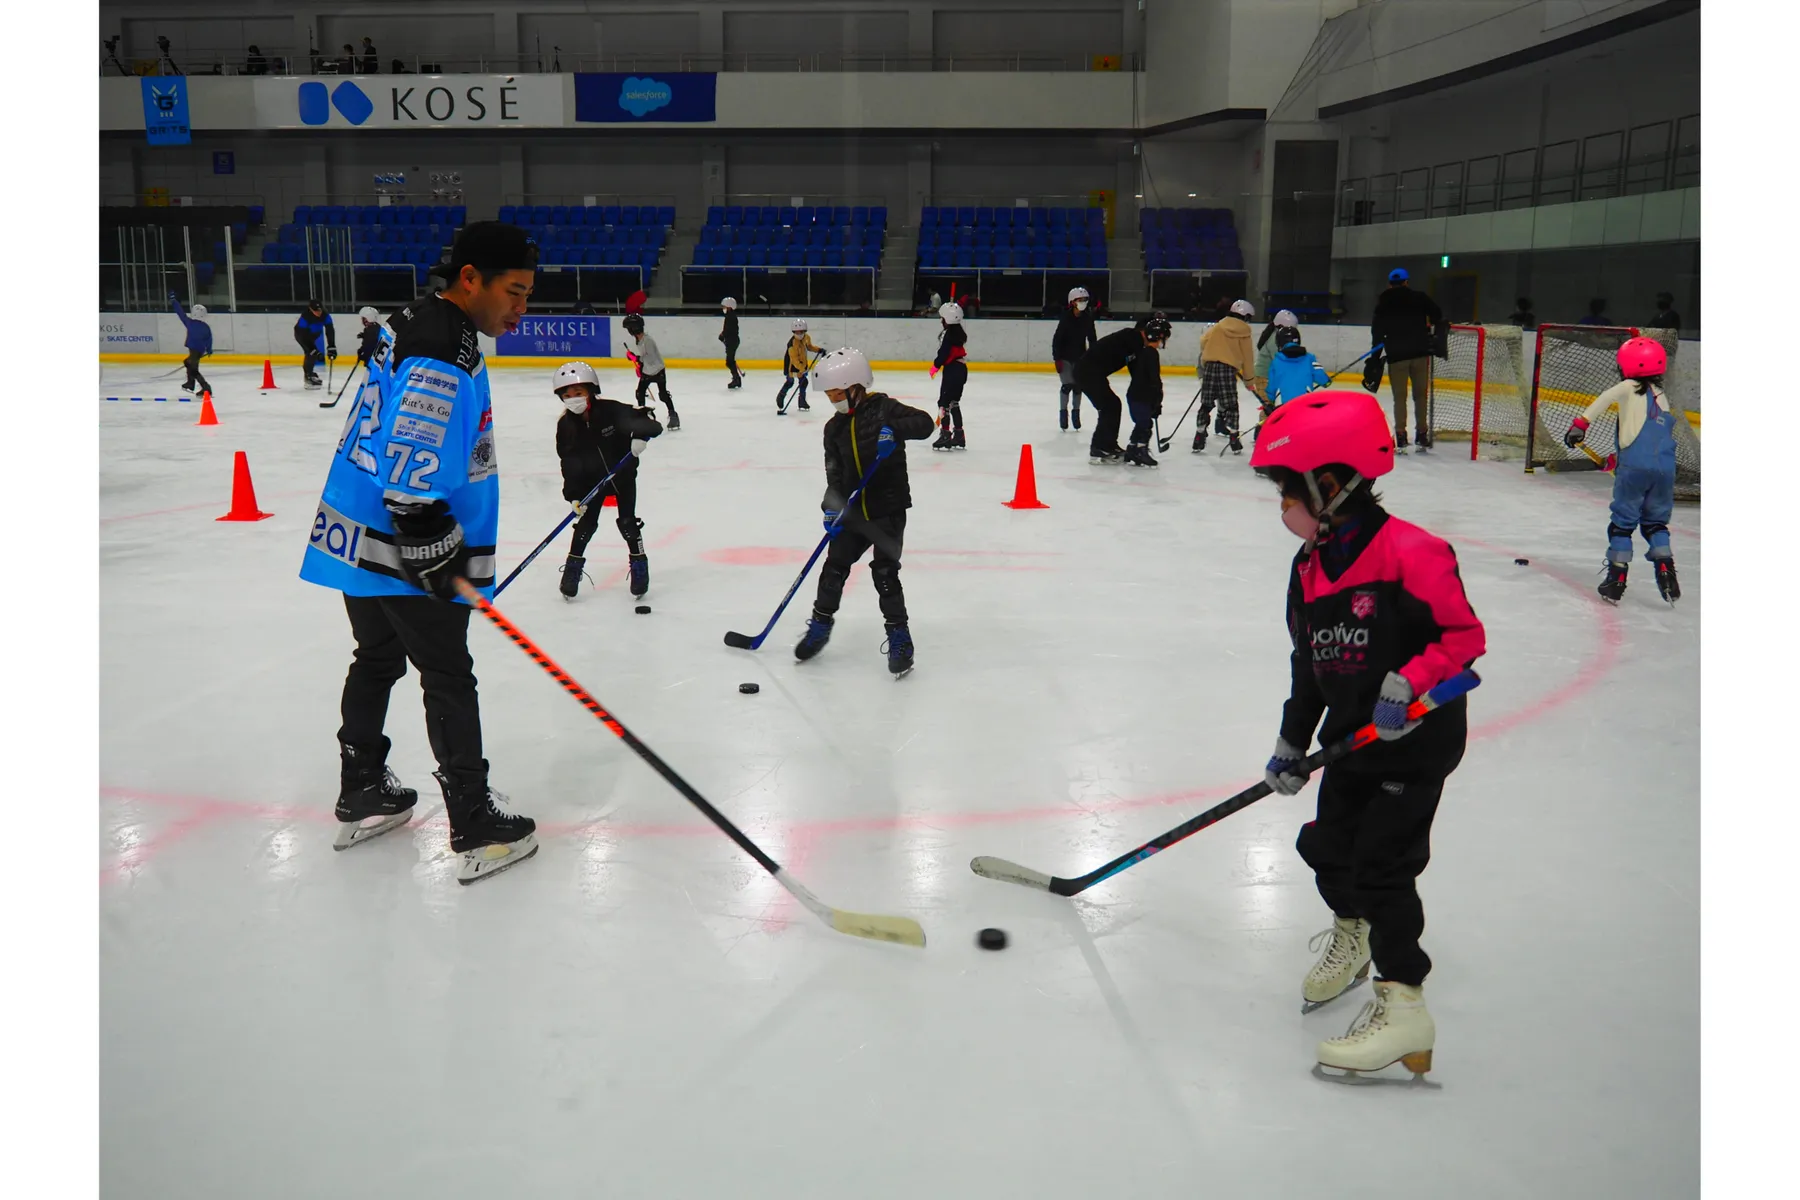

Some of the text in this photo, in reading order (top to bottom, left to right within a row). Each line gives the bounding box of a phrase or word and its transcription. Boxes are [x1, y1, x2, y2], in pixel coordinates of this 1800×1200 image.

[391, 77, 519, 121] KOSÉ
[625, 91, 667, 102] salesforce
[99, 324, 125, 333] KOSÉ
[534, 340, 573, 353] 雪肌精
[401, 396, 450, 417] Ritt's & Go
[414, 433, 438, 445] CENTER
[384, 440, 440, 492] 72
